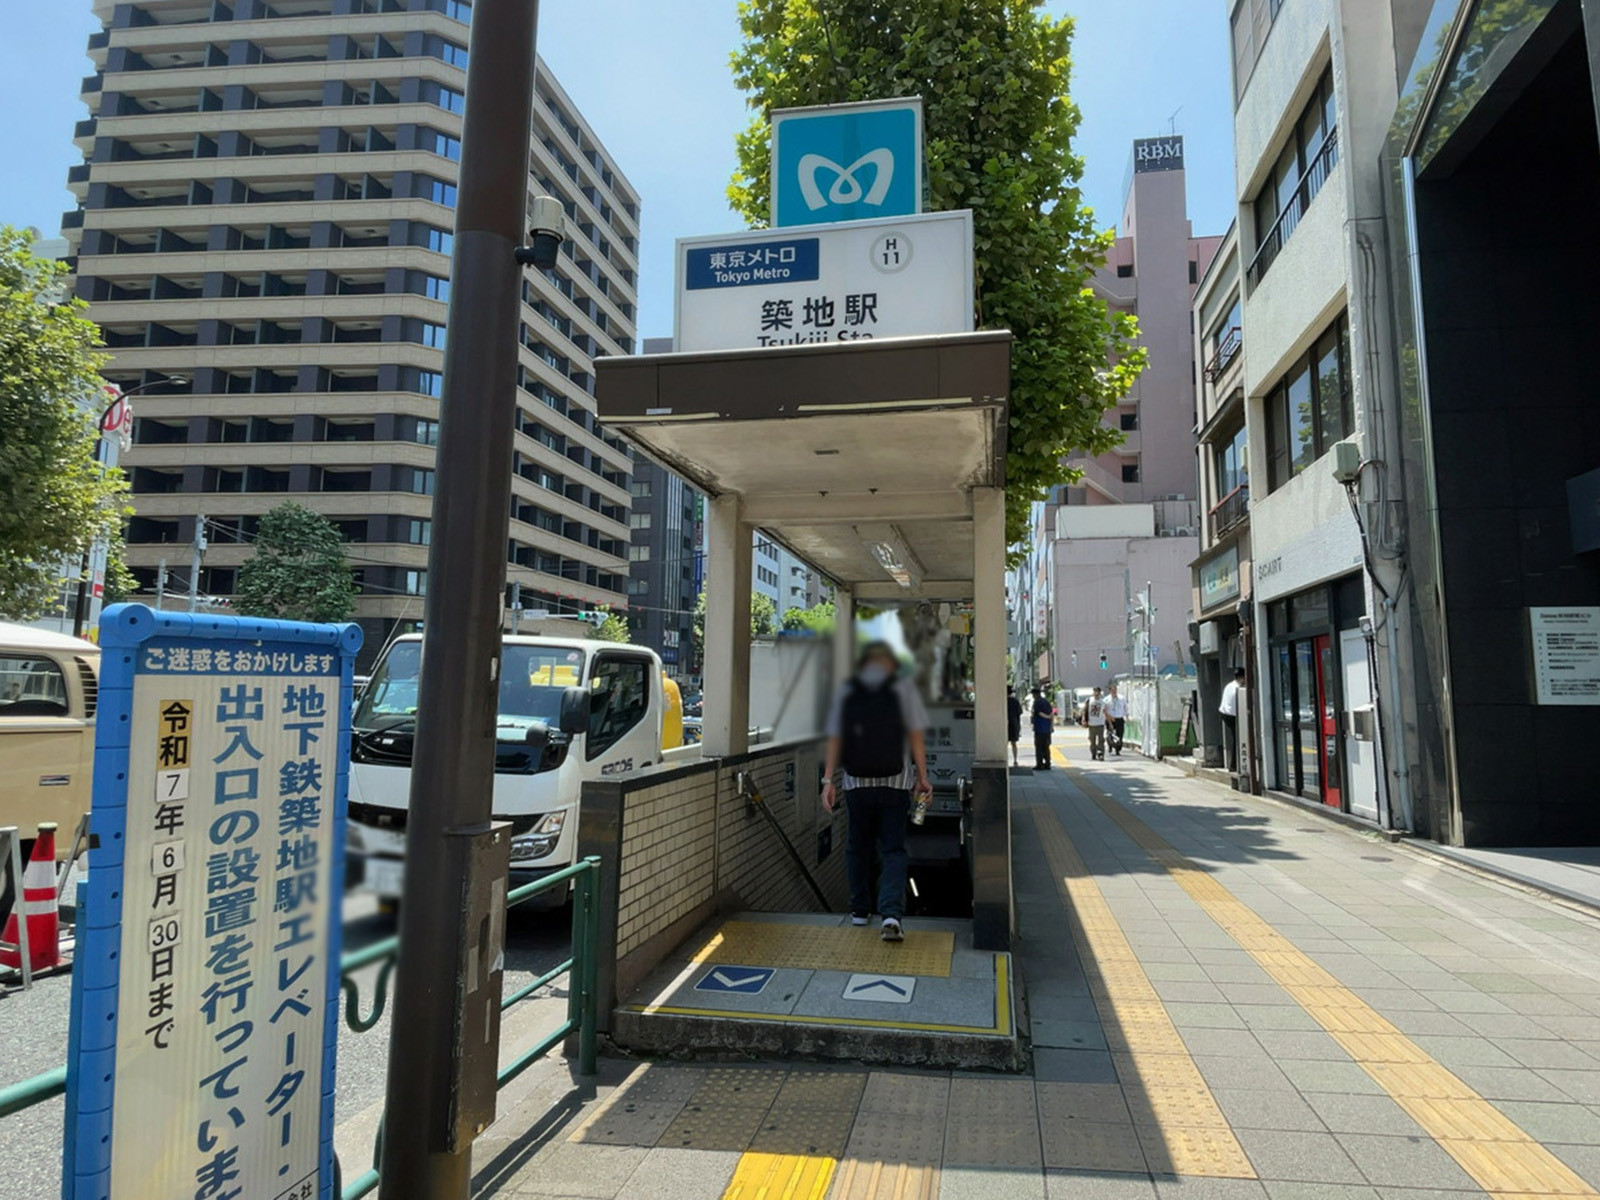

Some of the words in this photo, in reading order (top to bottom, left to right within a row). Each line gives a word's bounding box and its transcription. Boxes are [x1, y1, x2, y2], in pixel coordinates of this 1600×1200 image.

[1137, 143, 1182, 160] RBM
[886, 238, 897, 251] H
[709, 246, 796, 270] 東京メトロ
[883, 252, 900, 265] 11
[714, 271, 751, 285] Tokyo
[753, 267, 791, 281] Metro
[761, 292, 879, 332] 築地駅
[145, 647, 334, 674] ご迷惑をおかけします
[195, 683, 265, 1200] 出入口の設置を行っていま
